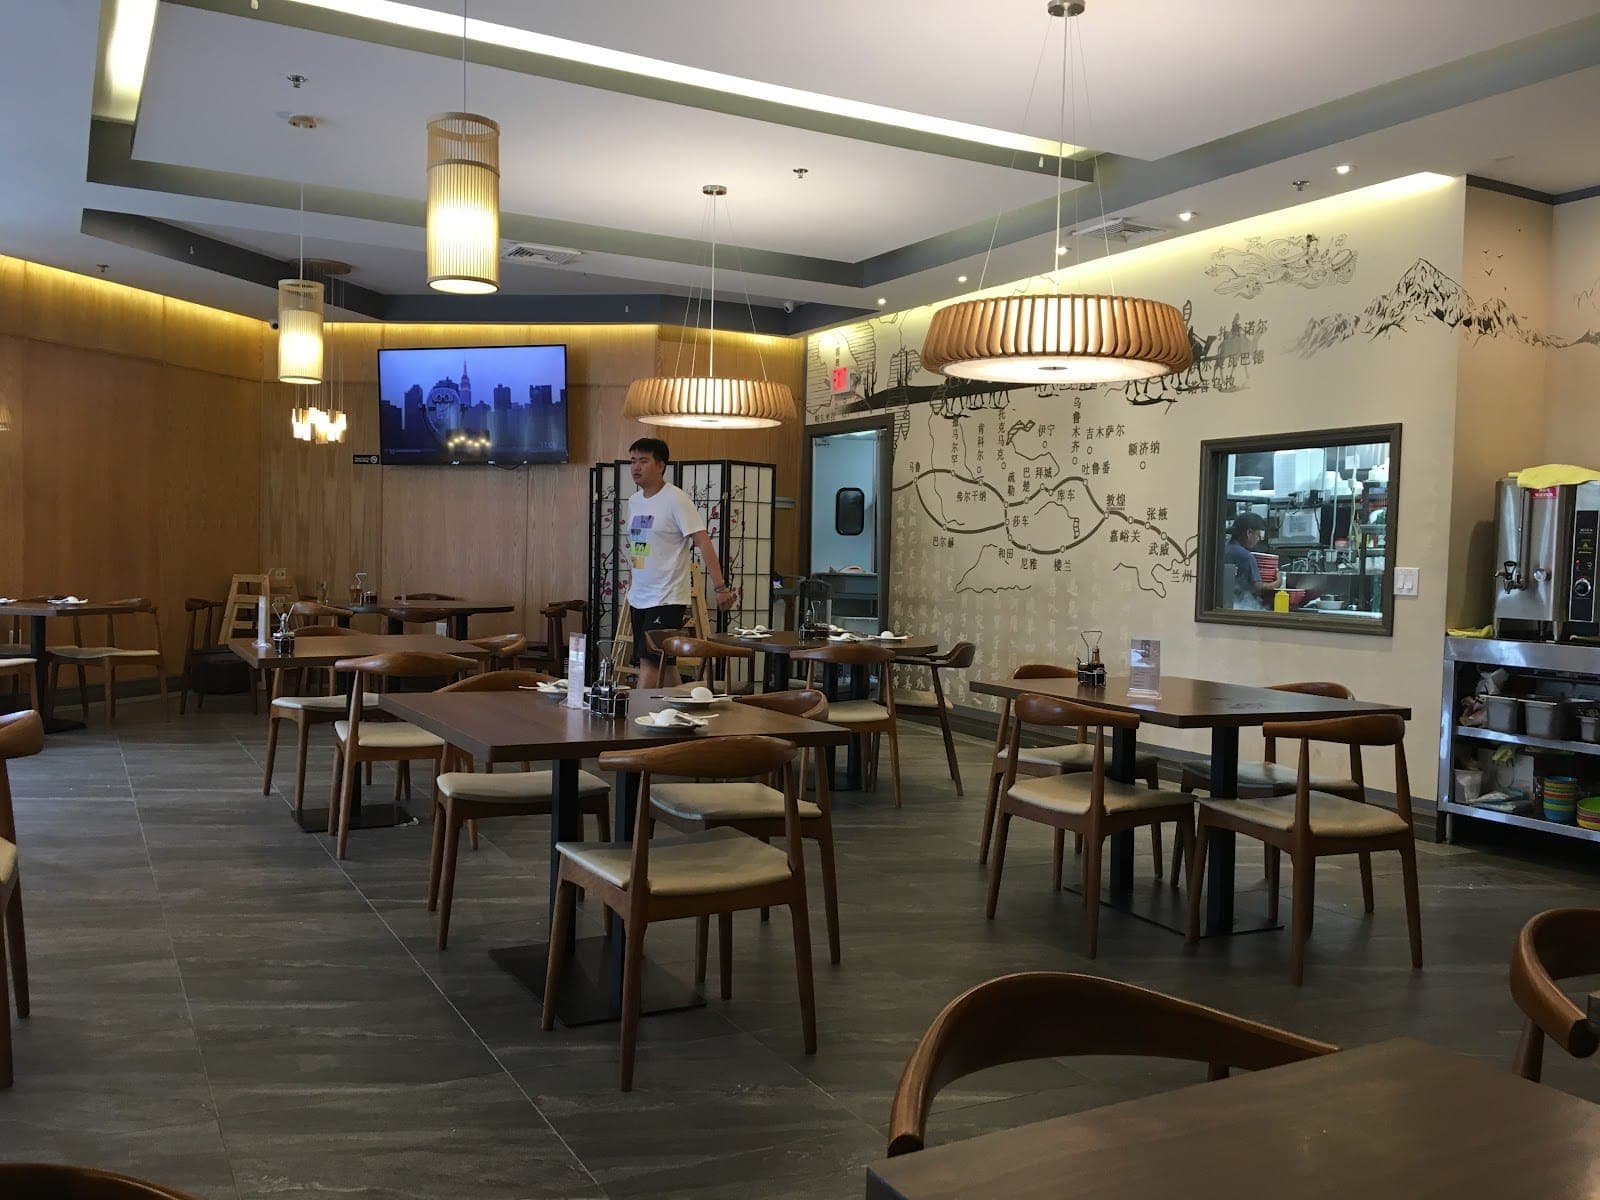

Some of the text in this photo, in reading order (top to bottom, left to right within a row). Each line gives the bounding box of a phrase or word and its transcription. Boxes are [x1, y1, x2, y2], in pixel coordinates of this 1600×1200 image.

[1038, 424, 1055, 437] 伊宁
[1072, 397, 1081, 453] 乌鲁木齐
[1086, 424, 1125, 440] 吉木萨尔
[1128, 440, 1160, 456] 额济纳
[1082, 461, 1110, 475] 吐鲁番
[1056, 489, 1075, 502] 库车
[1106, 493, 1126, 507] 敦煌
[1146, 507, 1168, 521] 张掖
[1109, 529, 1141, 543] 嘉峪关
[998, 548, 1014, 560] 和田
[1148, 542, 1170, 556] 武威
[1020, 558, 1037, 571] 尼雅
[1054, 559, 1072, 572] 楼兰
[1171, 569, 1192, 583] 兰州
